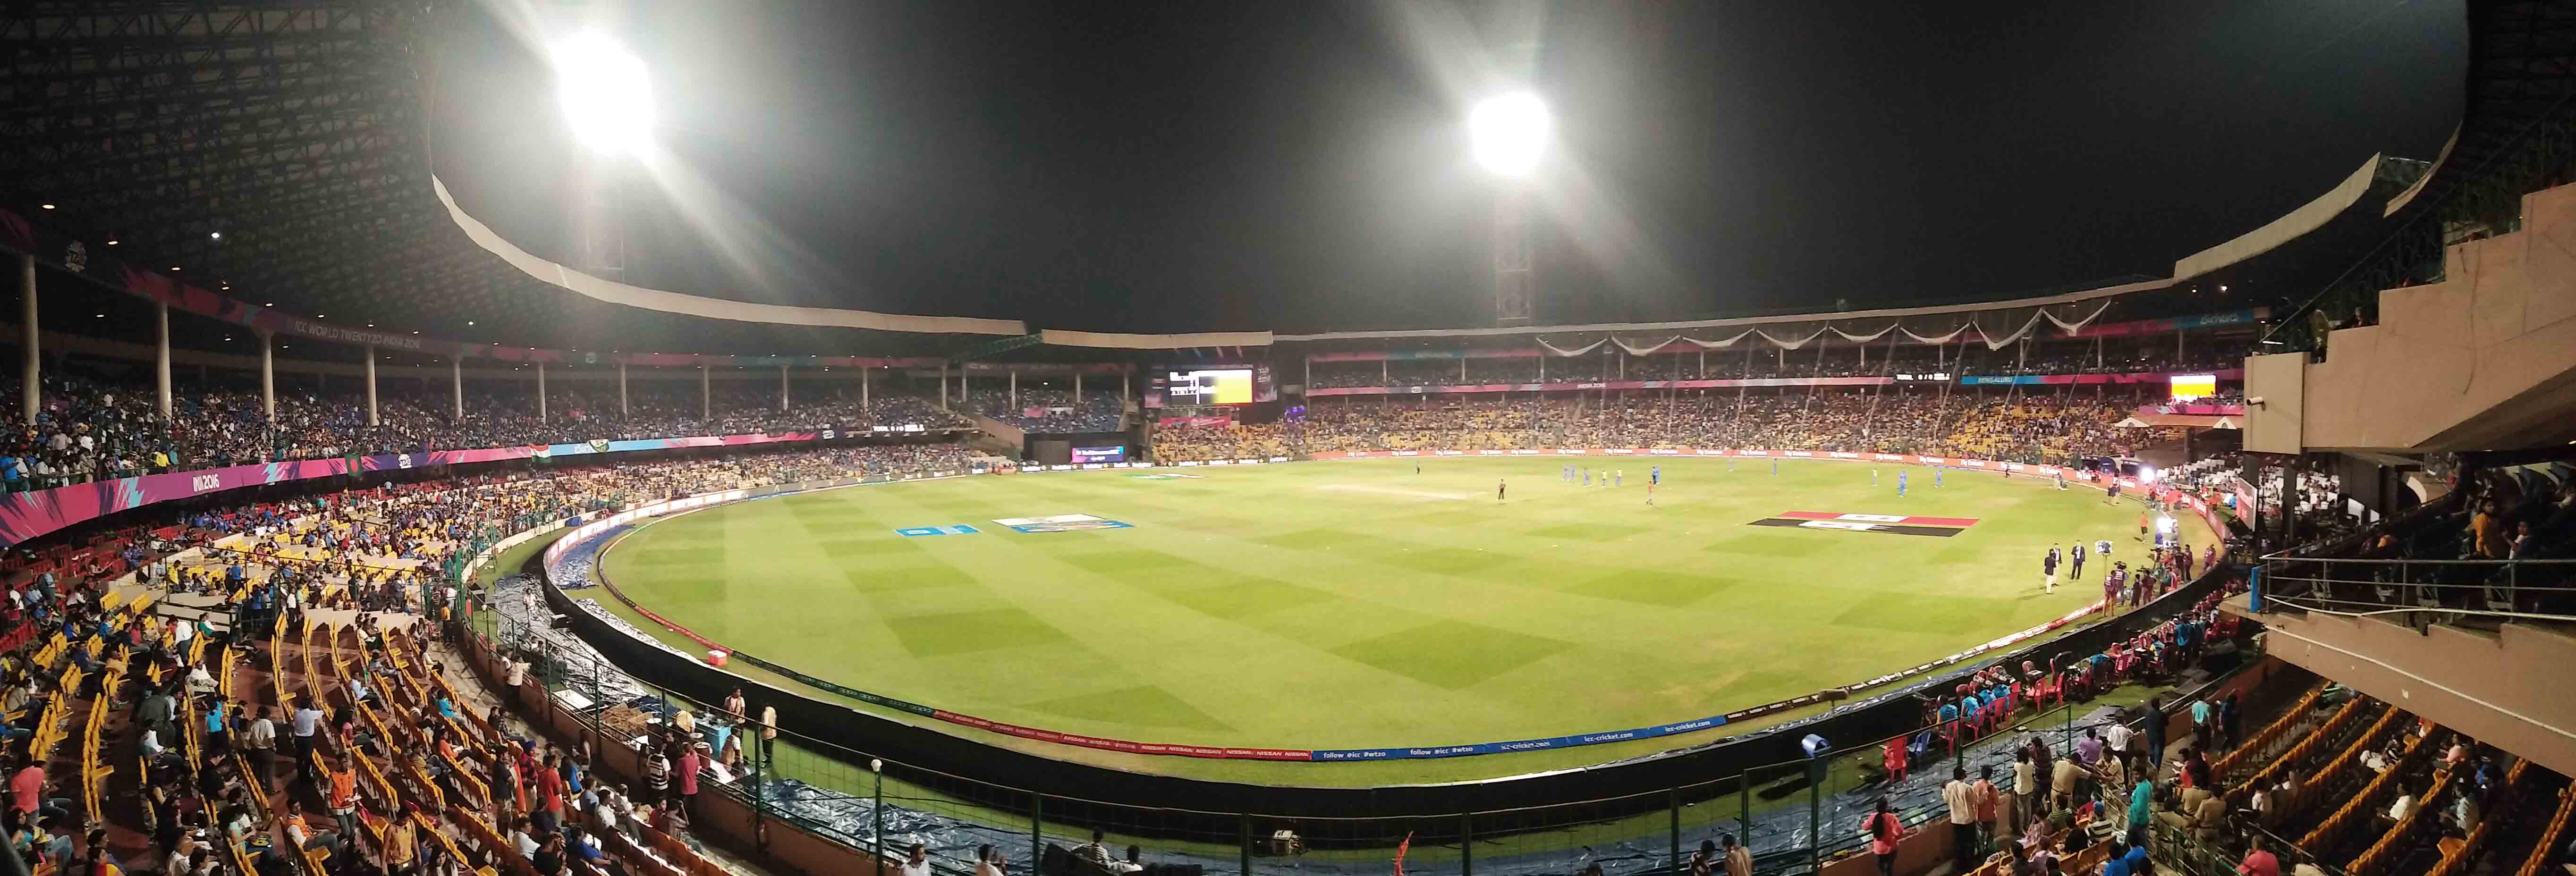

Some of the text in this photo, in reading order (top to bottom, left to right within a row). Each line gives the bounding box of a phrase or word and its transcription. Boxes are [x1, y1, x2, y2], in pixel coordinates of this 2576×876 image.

[295, 320, 307, 333] ICC
[309, 324, 338, 339] WORLD
[203, 474, 220, 489] 2016
[1665, 719, 1711, 732] icc-cricket.com
[1584, 732, 1634, 742] icc-cricket.com
